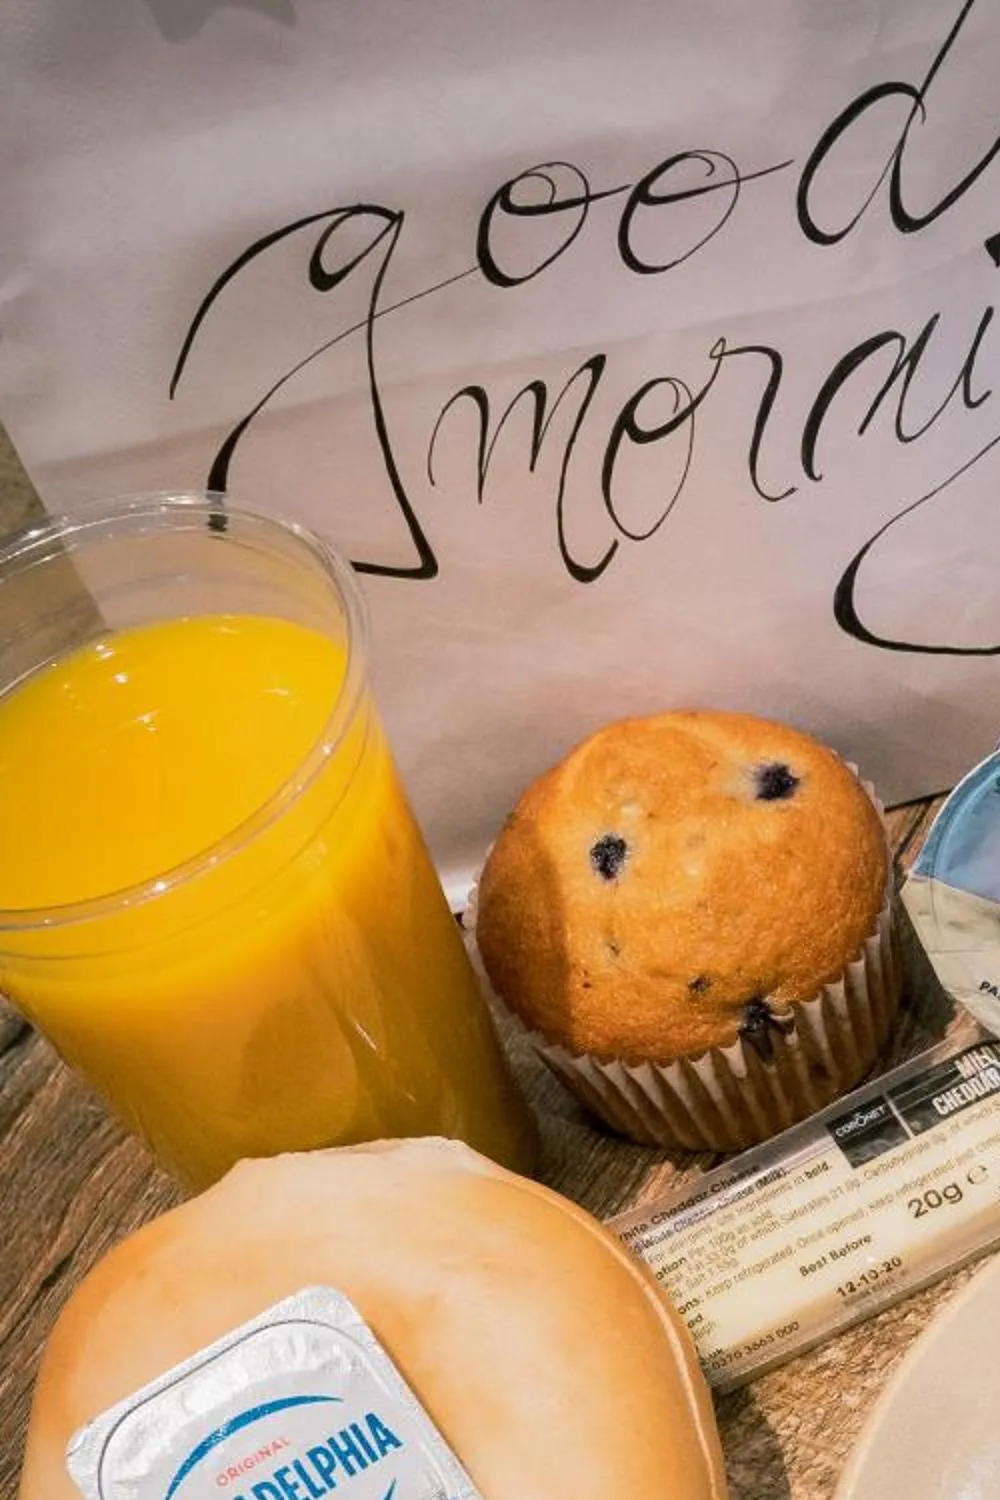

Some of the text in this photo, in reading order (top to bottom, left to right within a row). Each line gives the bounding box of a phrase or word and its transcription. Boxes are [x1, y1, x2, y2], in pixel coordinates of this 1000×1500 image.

[831, 1102, 888, 1139] CORONET
[648, 1189, 710, 1226] Cheddar
[708, 1162, 762, 1195] Cheese
[904, 1177, 965, 1220] 20g
[652, 1255, 689, 1281] ation
[797, 1231, 874, 1278] Best Before
[832, 1253, 905, 1299] 12-10-20
[216, 1437, 291, 1488] ORIGINAL
